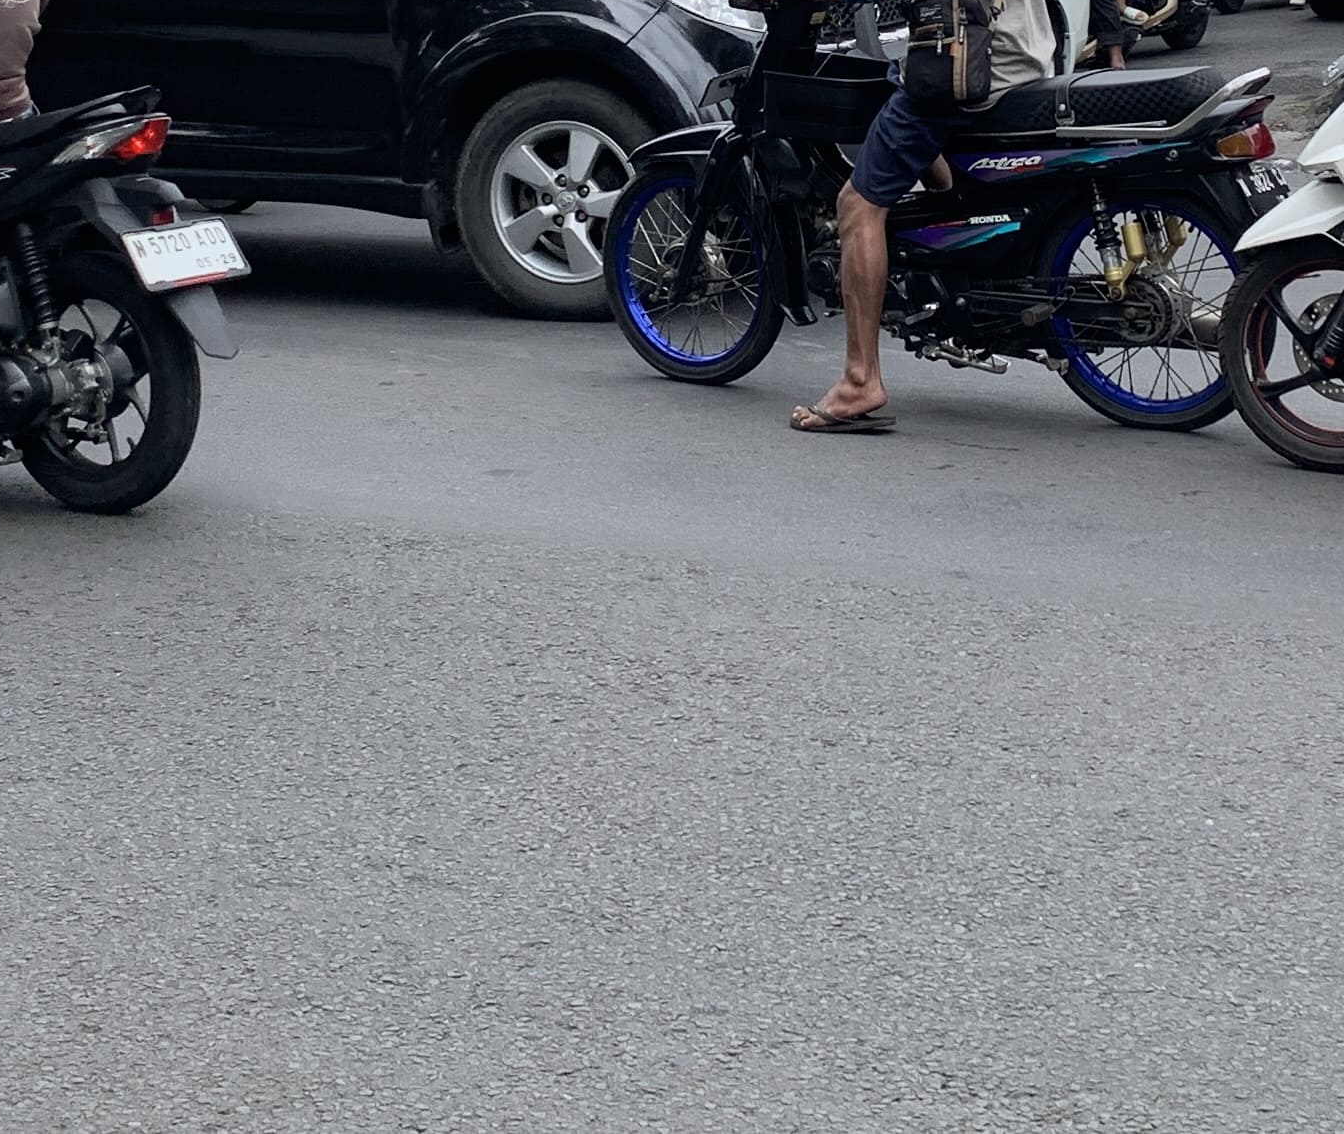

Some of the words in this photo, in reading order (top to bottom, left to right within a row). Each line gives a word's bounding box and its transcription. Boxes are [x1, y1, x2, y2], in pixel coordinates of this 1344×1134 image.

[968, 213, 1012, 225] HONDA
[132, 240, 147, 259] N
[147, 232, 191, 255] 5720
